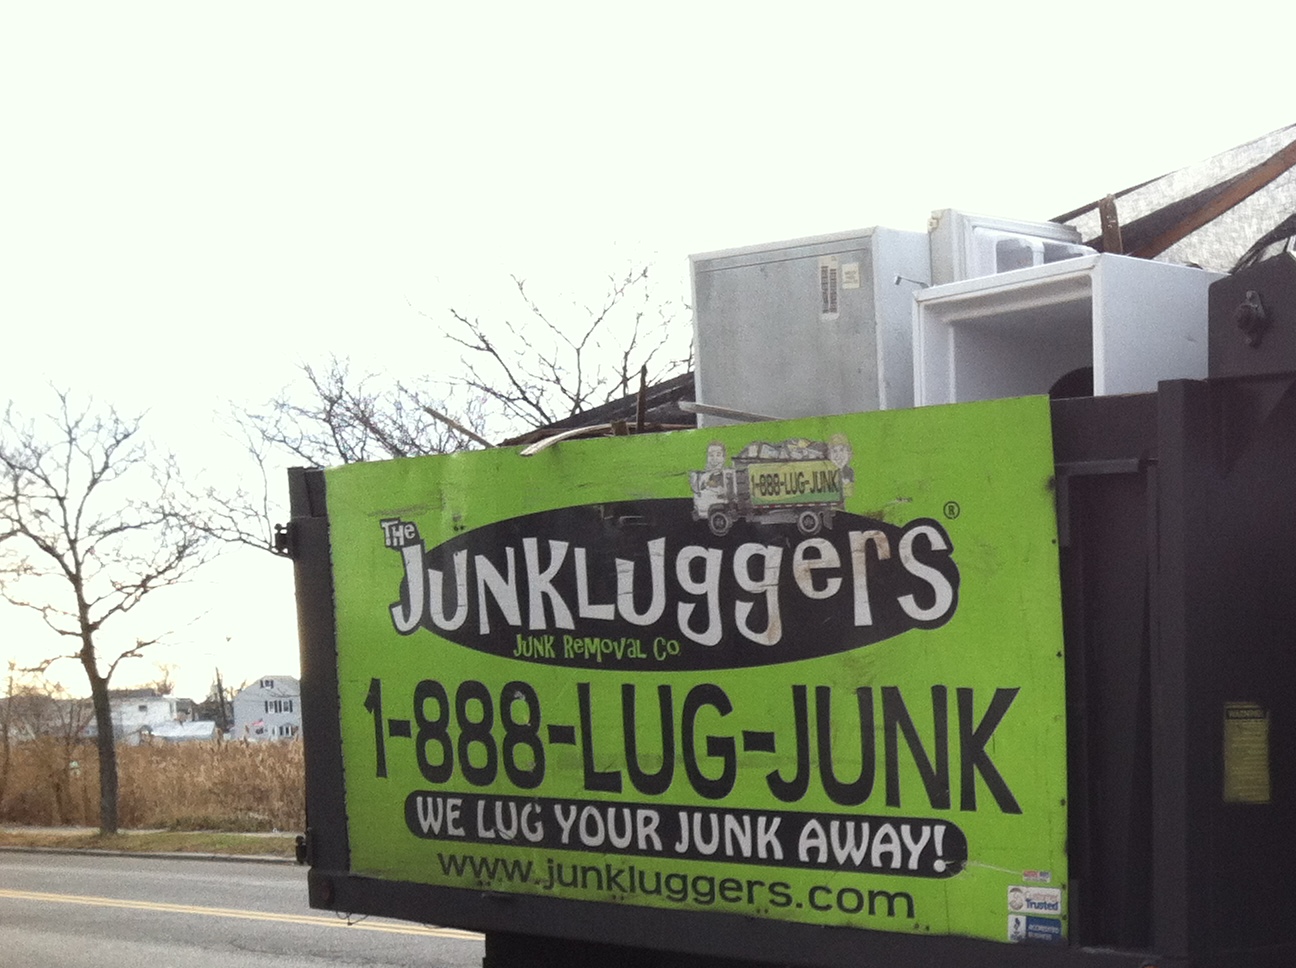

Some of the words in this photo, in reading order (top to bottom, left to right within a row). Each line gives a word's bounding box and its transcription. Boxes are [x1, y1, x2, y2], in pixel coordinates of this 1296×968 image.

[751, 468, 840, 497] 1-888-LUG-JUNK
[363, 678, 1023, 814] 1-888-LUG-JUNK
[415, 796, 465, 837] WE
[476, 800, 545, 842] LUG
[554, 804, 664, 851] YOUR
[674, 812, 785, 861] JUNK
[798, 818, 947, 873] AWAY!
[438, 851, 916, 919] www.junkluggers.com
[1025, 898, 1059, 911] Trusted
